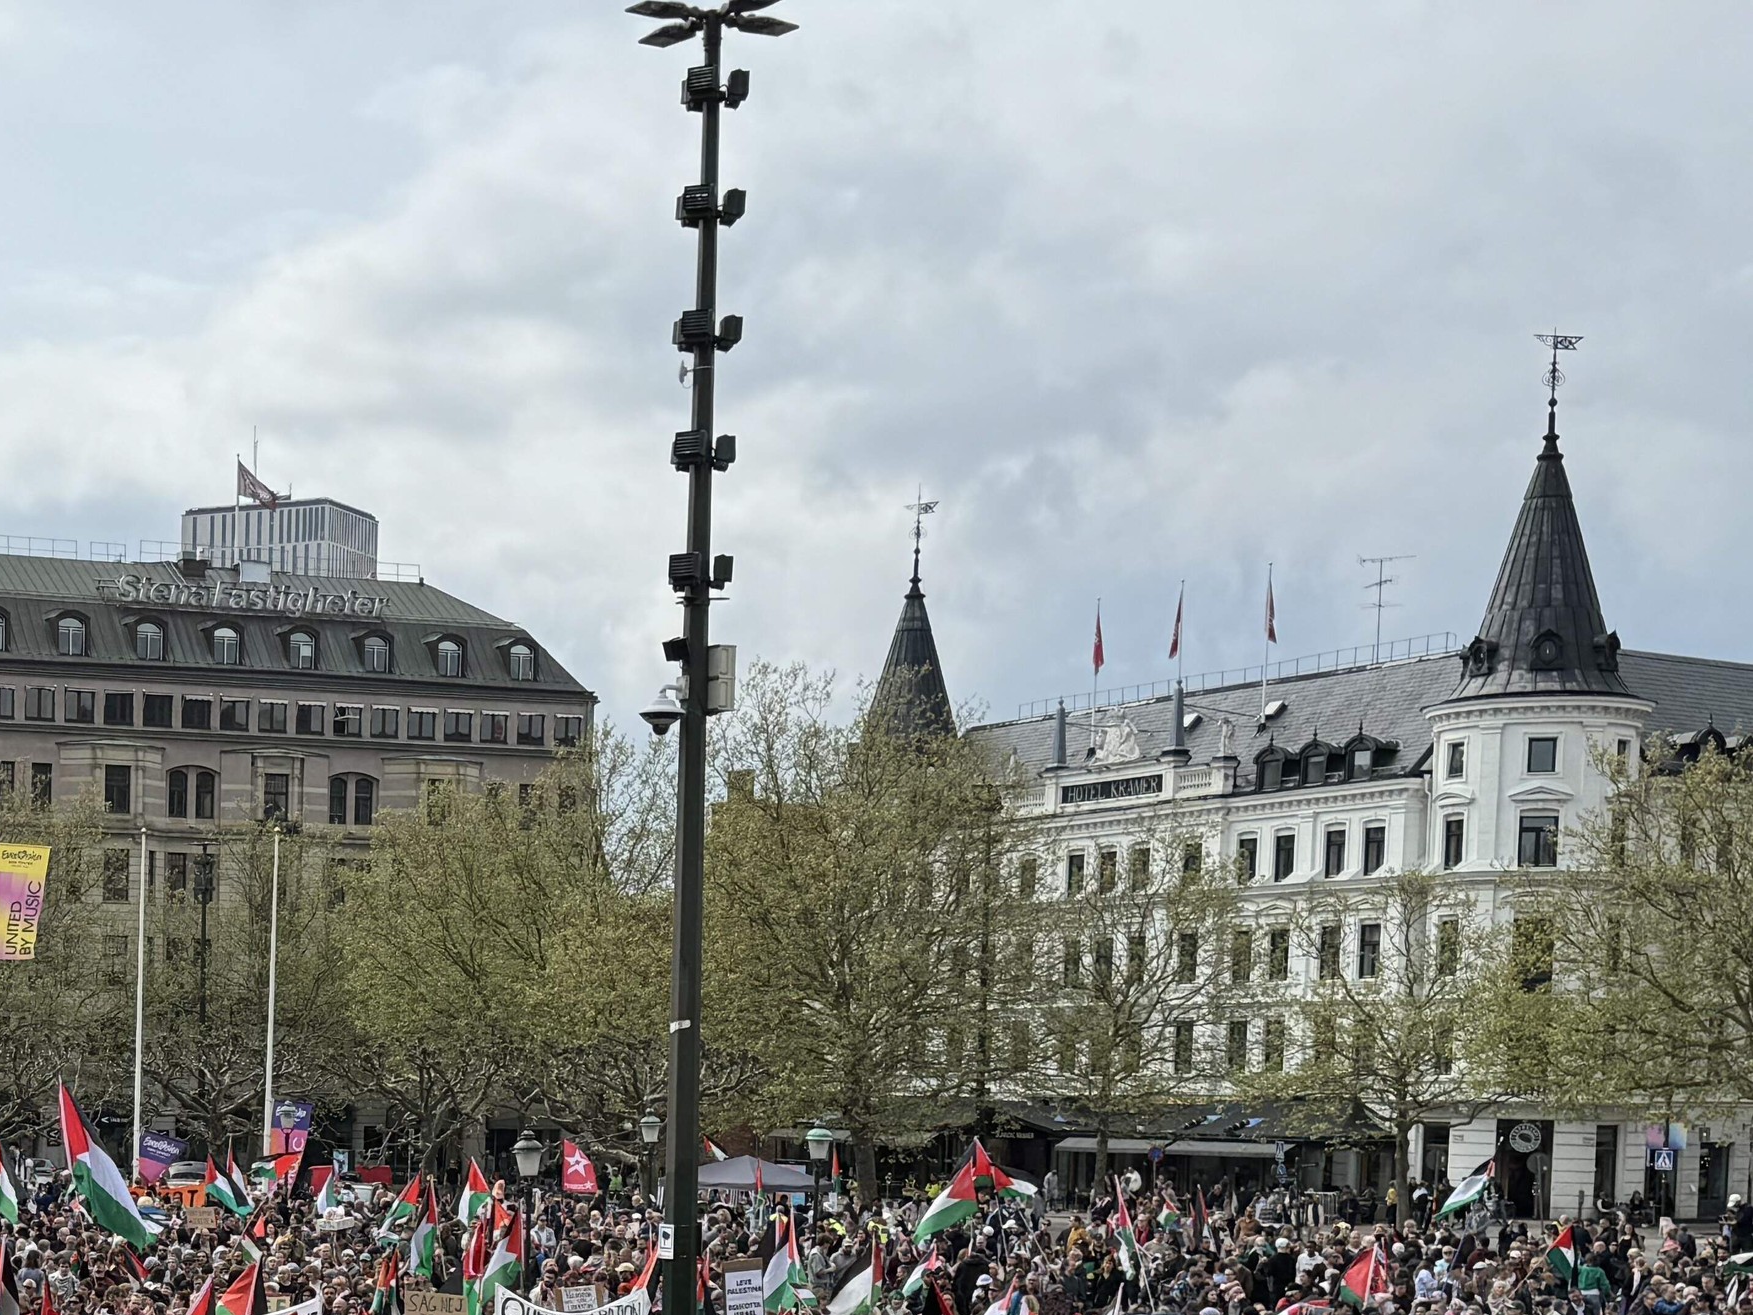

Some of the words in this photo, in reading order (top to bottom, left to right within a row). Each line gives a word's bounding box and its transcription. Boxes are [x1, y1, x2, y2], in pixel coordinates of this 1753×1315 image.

[118, 575, 208, 605] Stena
[213, 581, 390, 617] Fastigheter
[1067, 784, 1106, 802] HOTEL
[1109, 776, 1159, 798] KRAMER
[22, 881, 42, 933] MUSIC
[5, 901, 23, 955] UNITED
[19, 938, 34, 955] BY
[727, 1286, 763, 1295] PALESTINA
